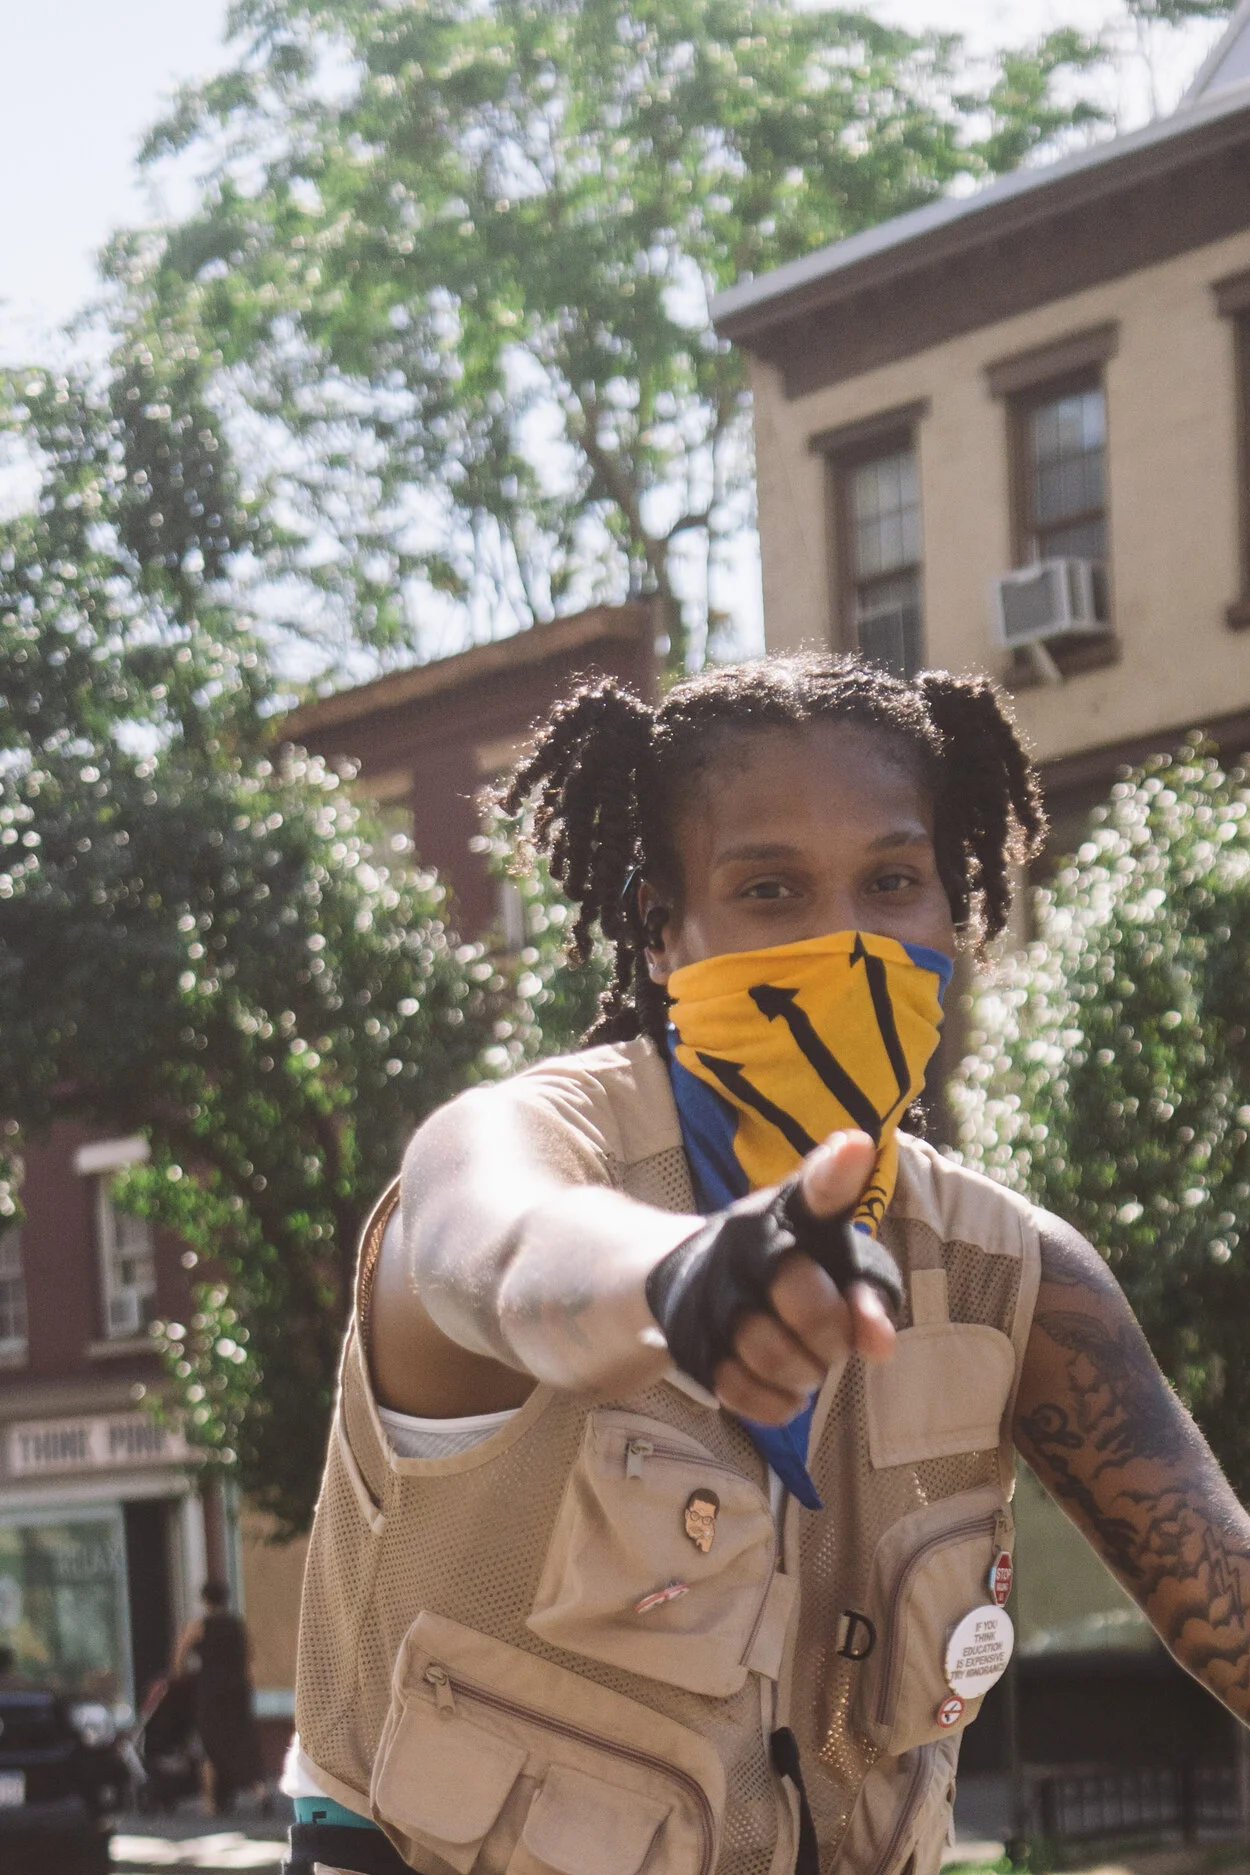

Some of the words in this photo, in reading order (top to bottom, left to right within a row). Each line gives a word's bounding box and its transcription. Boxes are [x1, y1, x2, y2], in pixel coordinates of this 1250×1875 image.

[995, 1567, 1012, 1581] STOP
[975, 1621, 983, 1632] IF
[984, 1619, 998, 1630] YOU
[974, 1630, 996, 1643] THINK
[963, 1641, 1003, 1656] EDUCATION
[956, 1659, 964, 1669] IS
[965, 1651, 1005, 1667] EXPENSIVE
[951, 1669, 965, 1681] TRY
